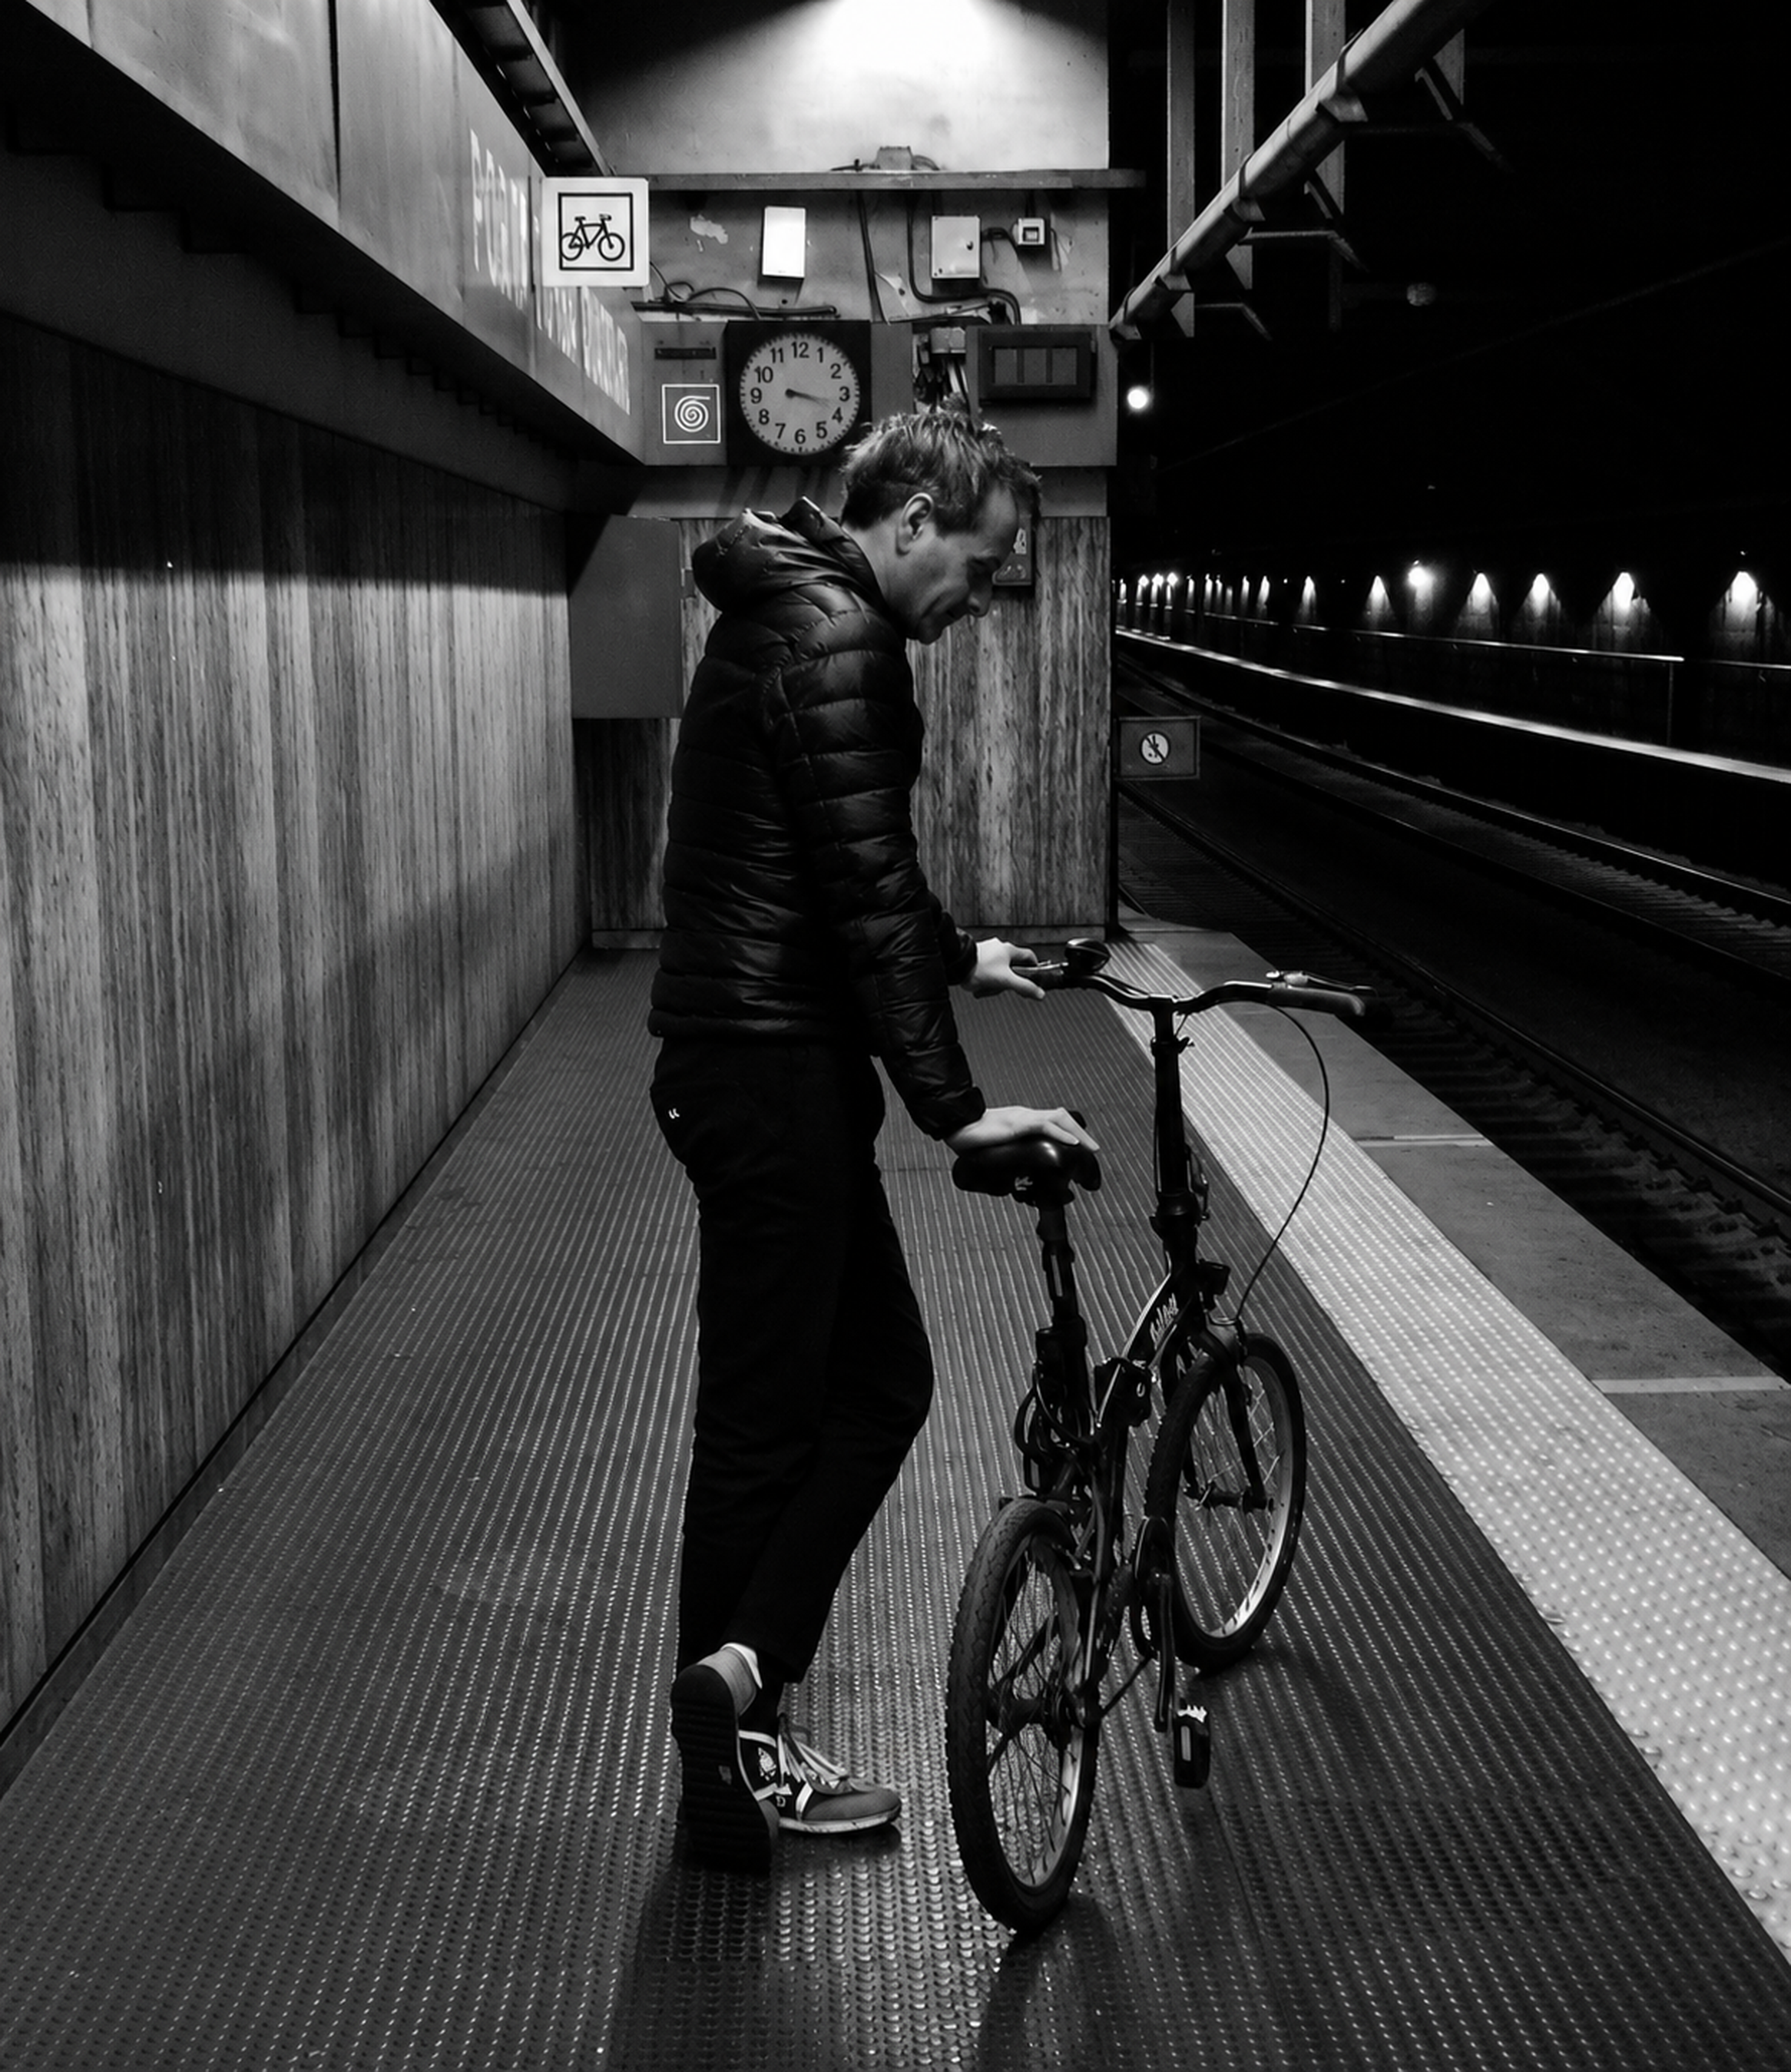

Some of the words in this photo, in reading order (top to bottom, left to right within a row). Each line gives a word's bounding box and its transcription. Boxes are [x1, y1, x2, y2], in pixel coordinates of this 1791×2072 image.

[770, 348, 784, 363] 11
[792, 342, 809, 359] 12
[817, 347, 823, 362] 1
[754, 366, 773, 382] 10
[830, 363, 842, 379] 2
[750, 388, 762, 404] 9
[839, 386, 850, 402] 3
[759, 409, 770, 425] 8
[832, 407, 843, 423] 4
[775, 423, 786, 439] 7
[795, 429, 806, 444] 6
[816, 421, 827, 439] 5
